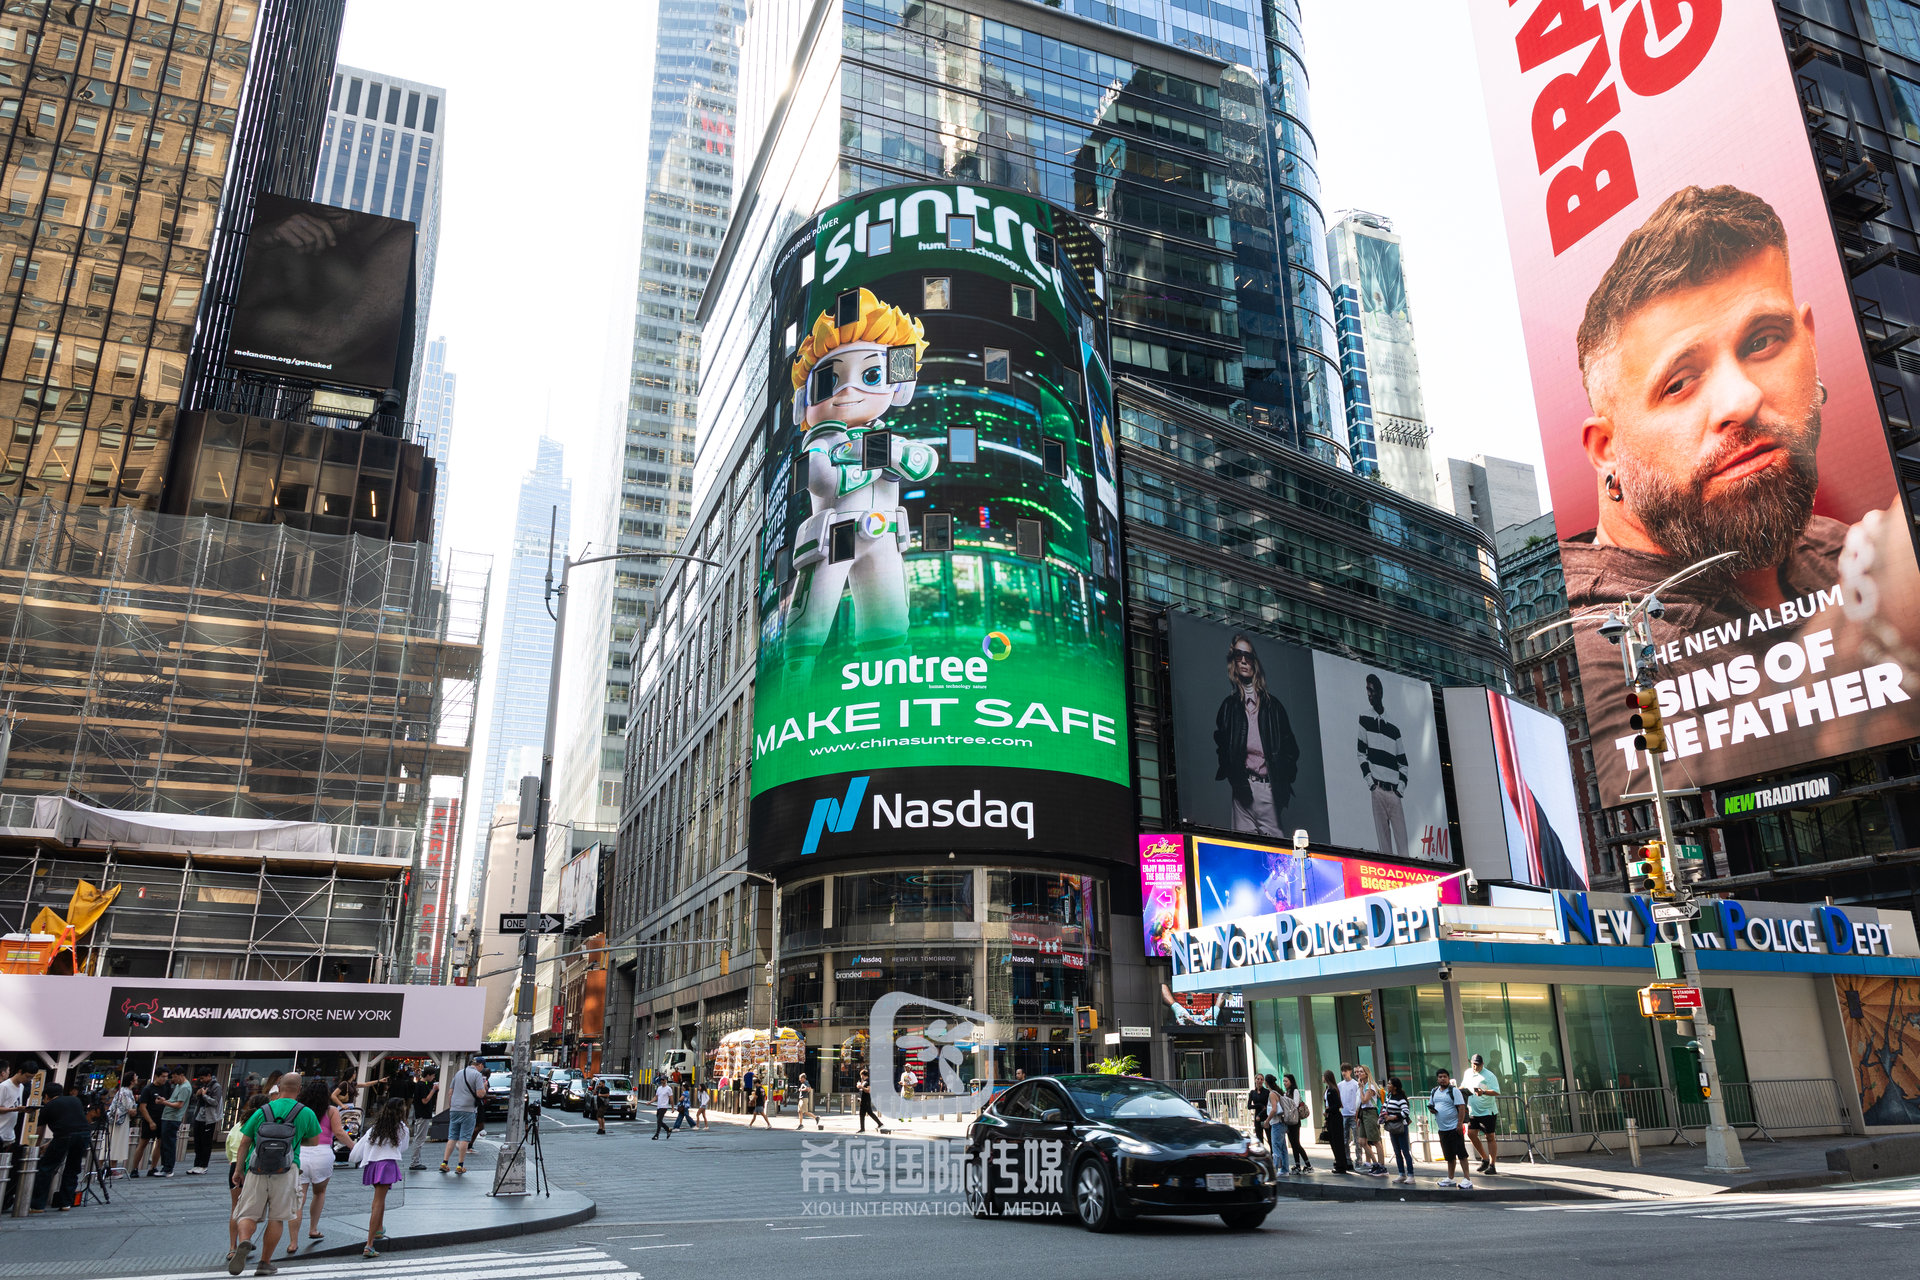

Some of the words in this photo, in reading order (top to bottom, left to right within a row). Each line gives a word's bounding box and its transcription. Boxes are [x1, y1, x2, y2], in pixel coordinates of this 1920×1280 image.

[1509, 0, 1639, 258] BRA
[812, 217, 839, 237] POWER
[234, 349, 332, 370] melanoma.org/getnaked
[1656, 640, 1682, 666] HE
[1684, 618, 1742, 657] NEW
[1747, 584, 1844, 636] ALBUM
[841, 654, 988, 690] suntree
[1653, 654, 1760, 719] SINS
[1764, 628, 1835, 684] OF
[1704, 662, 1911, 750] FATHER
[755, 702, 880, 760] MAKE
[900, 698, 959, 728] IT
[974, 698, 1117, 746] SAFE
[809, 734, 1033, 756] www.chinasuntree.com
[1724, 777, 1830, 815] NEWTRADITION
[873, 789, 1035, 840] Nasdaq
[427, 807, 447, 867] PARK
[1421, 825, 1449, 860] H&M
[1142, 864, 1157, 873] ENJOY
[1166, 865, 1176, 873] FEES
[1146, 873, 1155, 881] THE
[1166, 873, 1181, 881] OFFICE
[1361, 876, 1404, 891] BIGGEST
[506, 919, 524, 928] ONE
[540, 919, 552, 928] AY
[1553, 889, 1633, 945] NEW
[1717, 900, 1821, 953] POLICE
[1819, 906, 1893, 955] DEPT
[1657, 908, 1672, 917] ONE
[1677, 906, 1693, 914] WAY
[415, 903, 436, 966] PARK
[1171, 930, 1219, 976] NEW
[1214, 923, 1275, 970] YORK
[1275, 913, 1363, 961] POLICE
[1364, 896, 1444, 948] DEPT
[835, 968, 881, 980] brandedcities
[861, 956, 882, 964] Nasdaq
[1012, 956, 1034, 964] Nasdaq
[162, 1006, 222, 1019] TAMASHII
[282, 1008, 323, 1022] STORE
[326, 1009, 356, 1021] NEW
[358, 1009, 392, 1021] YORK
[1018, 999, 1040, 1007] Nasdaq
